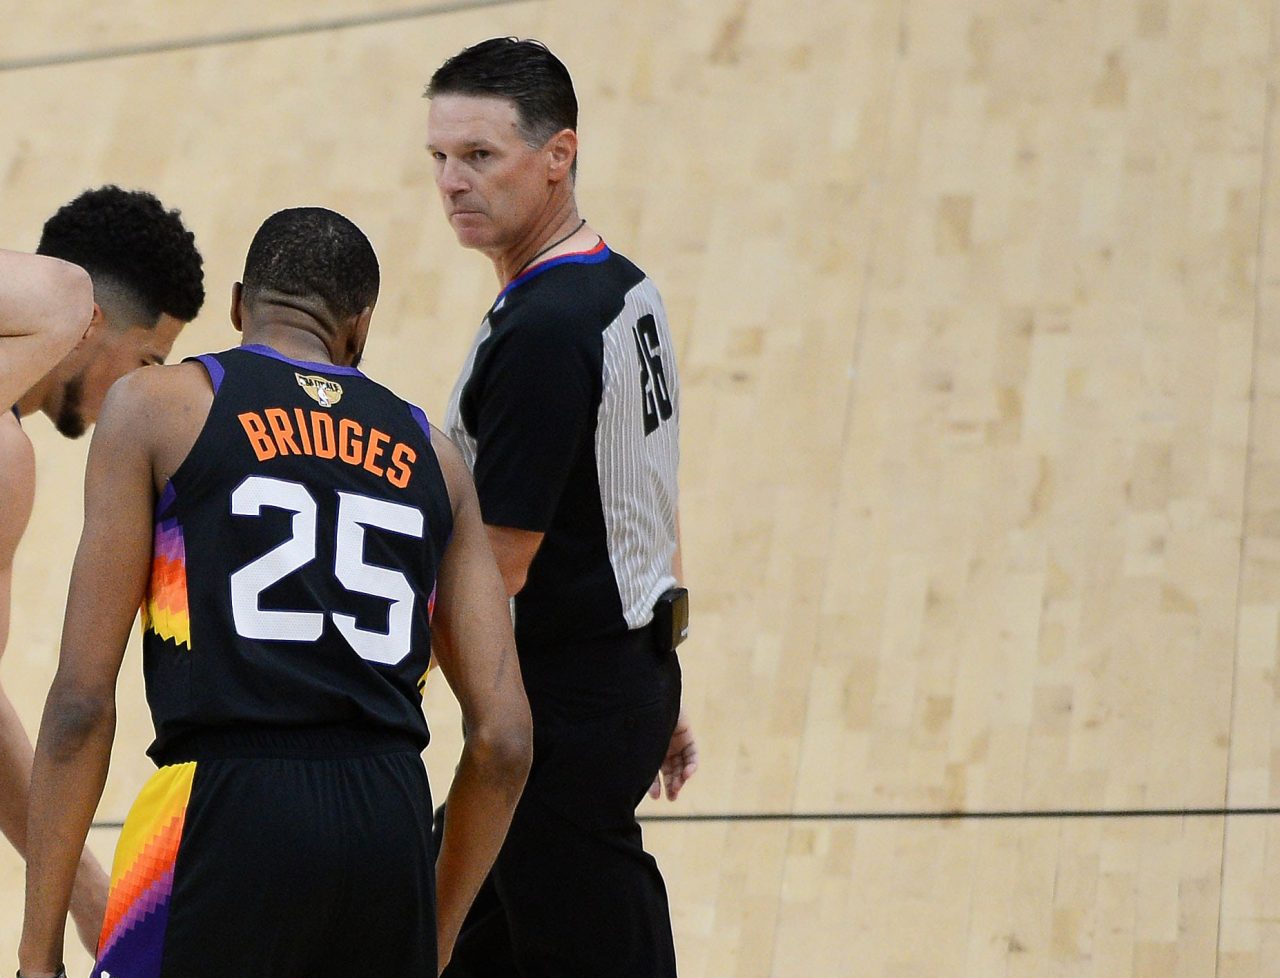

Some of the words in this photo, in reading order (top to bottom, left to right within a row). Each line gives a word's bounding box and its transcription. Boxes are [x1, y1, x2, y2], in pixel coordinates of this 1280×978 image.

[631, 313, 673, 437] 26
[237, 407, 417, 489] BRIDGES
[230, 476, 424, 667] 25
